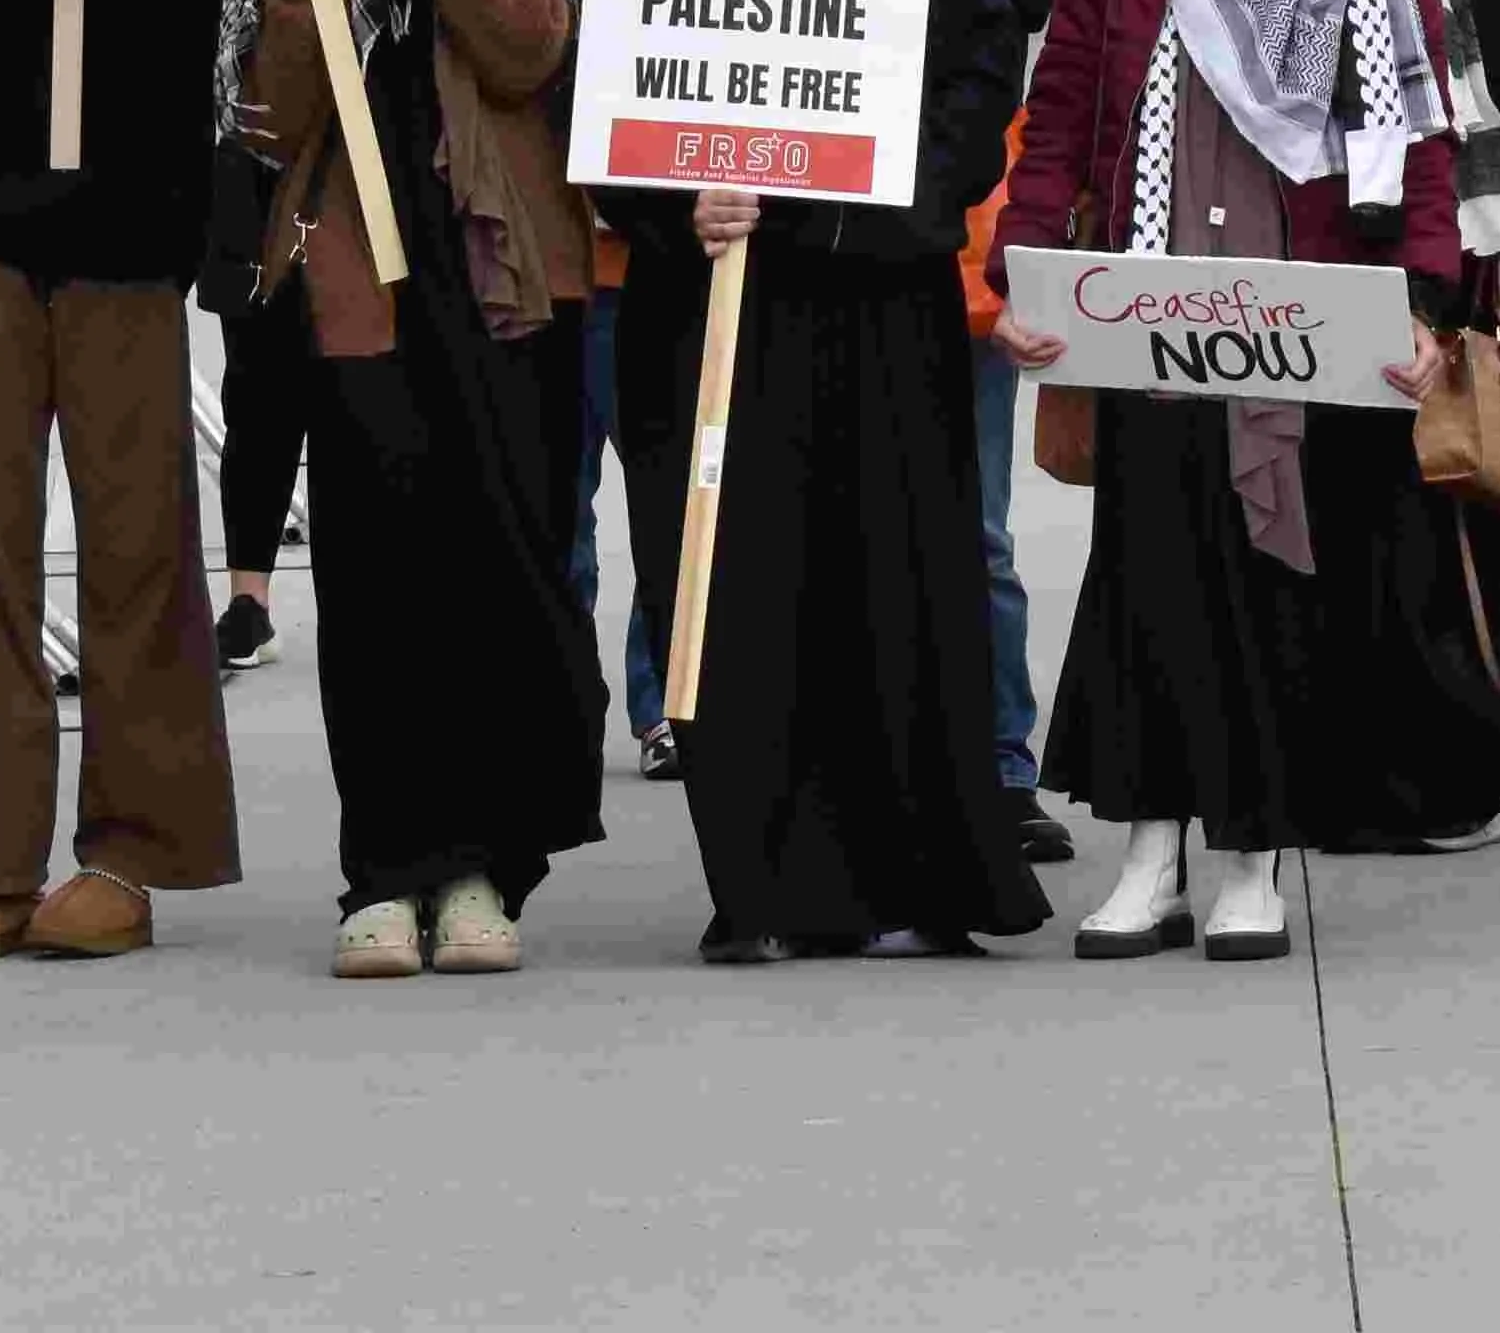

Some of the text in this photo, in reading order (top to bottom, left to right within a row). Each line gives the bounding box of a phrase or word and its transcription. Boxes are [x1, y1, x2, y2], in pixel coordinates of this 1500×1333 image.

[635, 56, 863, 114] WILL BE FREE
[1074, 266, 1325, 334] Ceasefire
[1150, 330, 1318, 383] NOW
